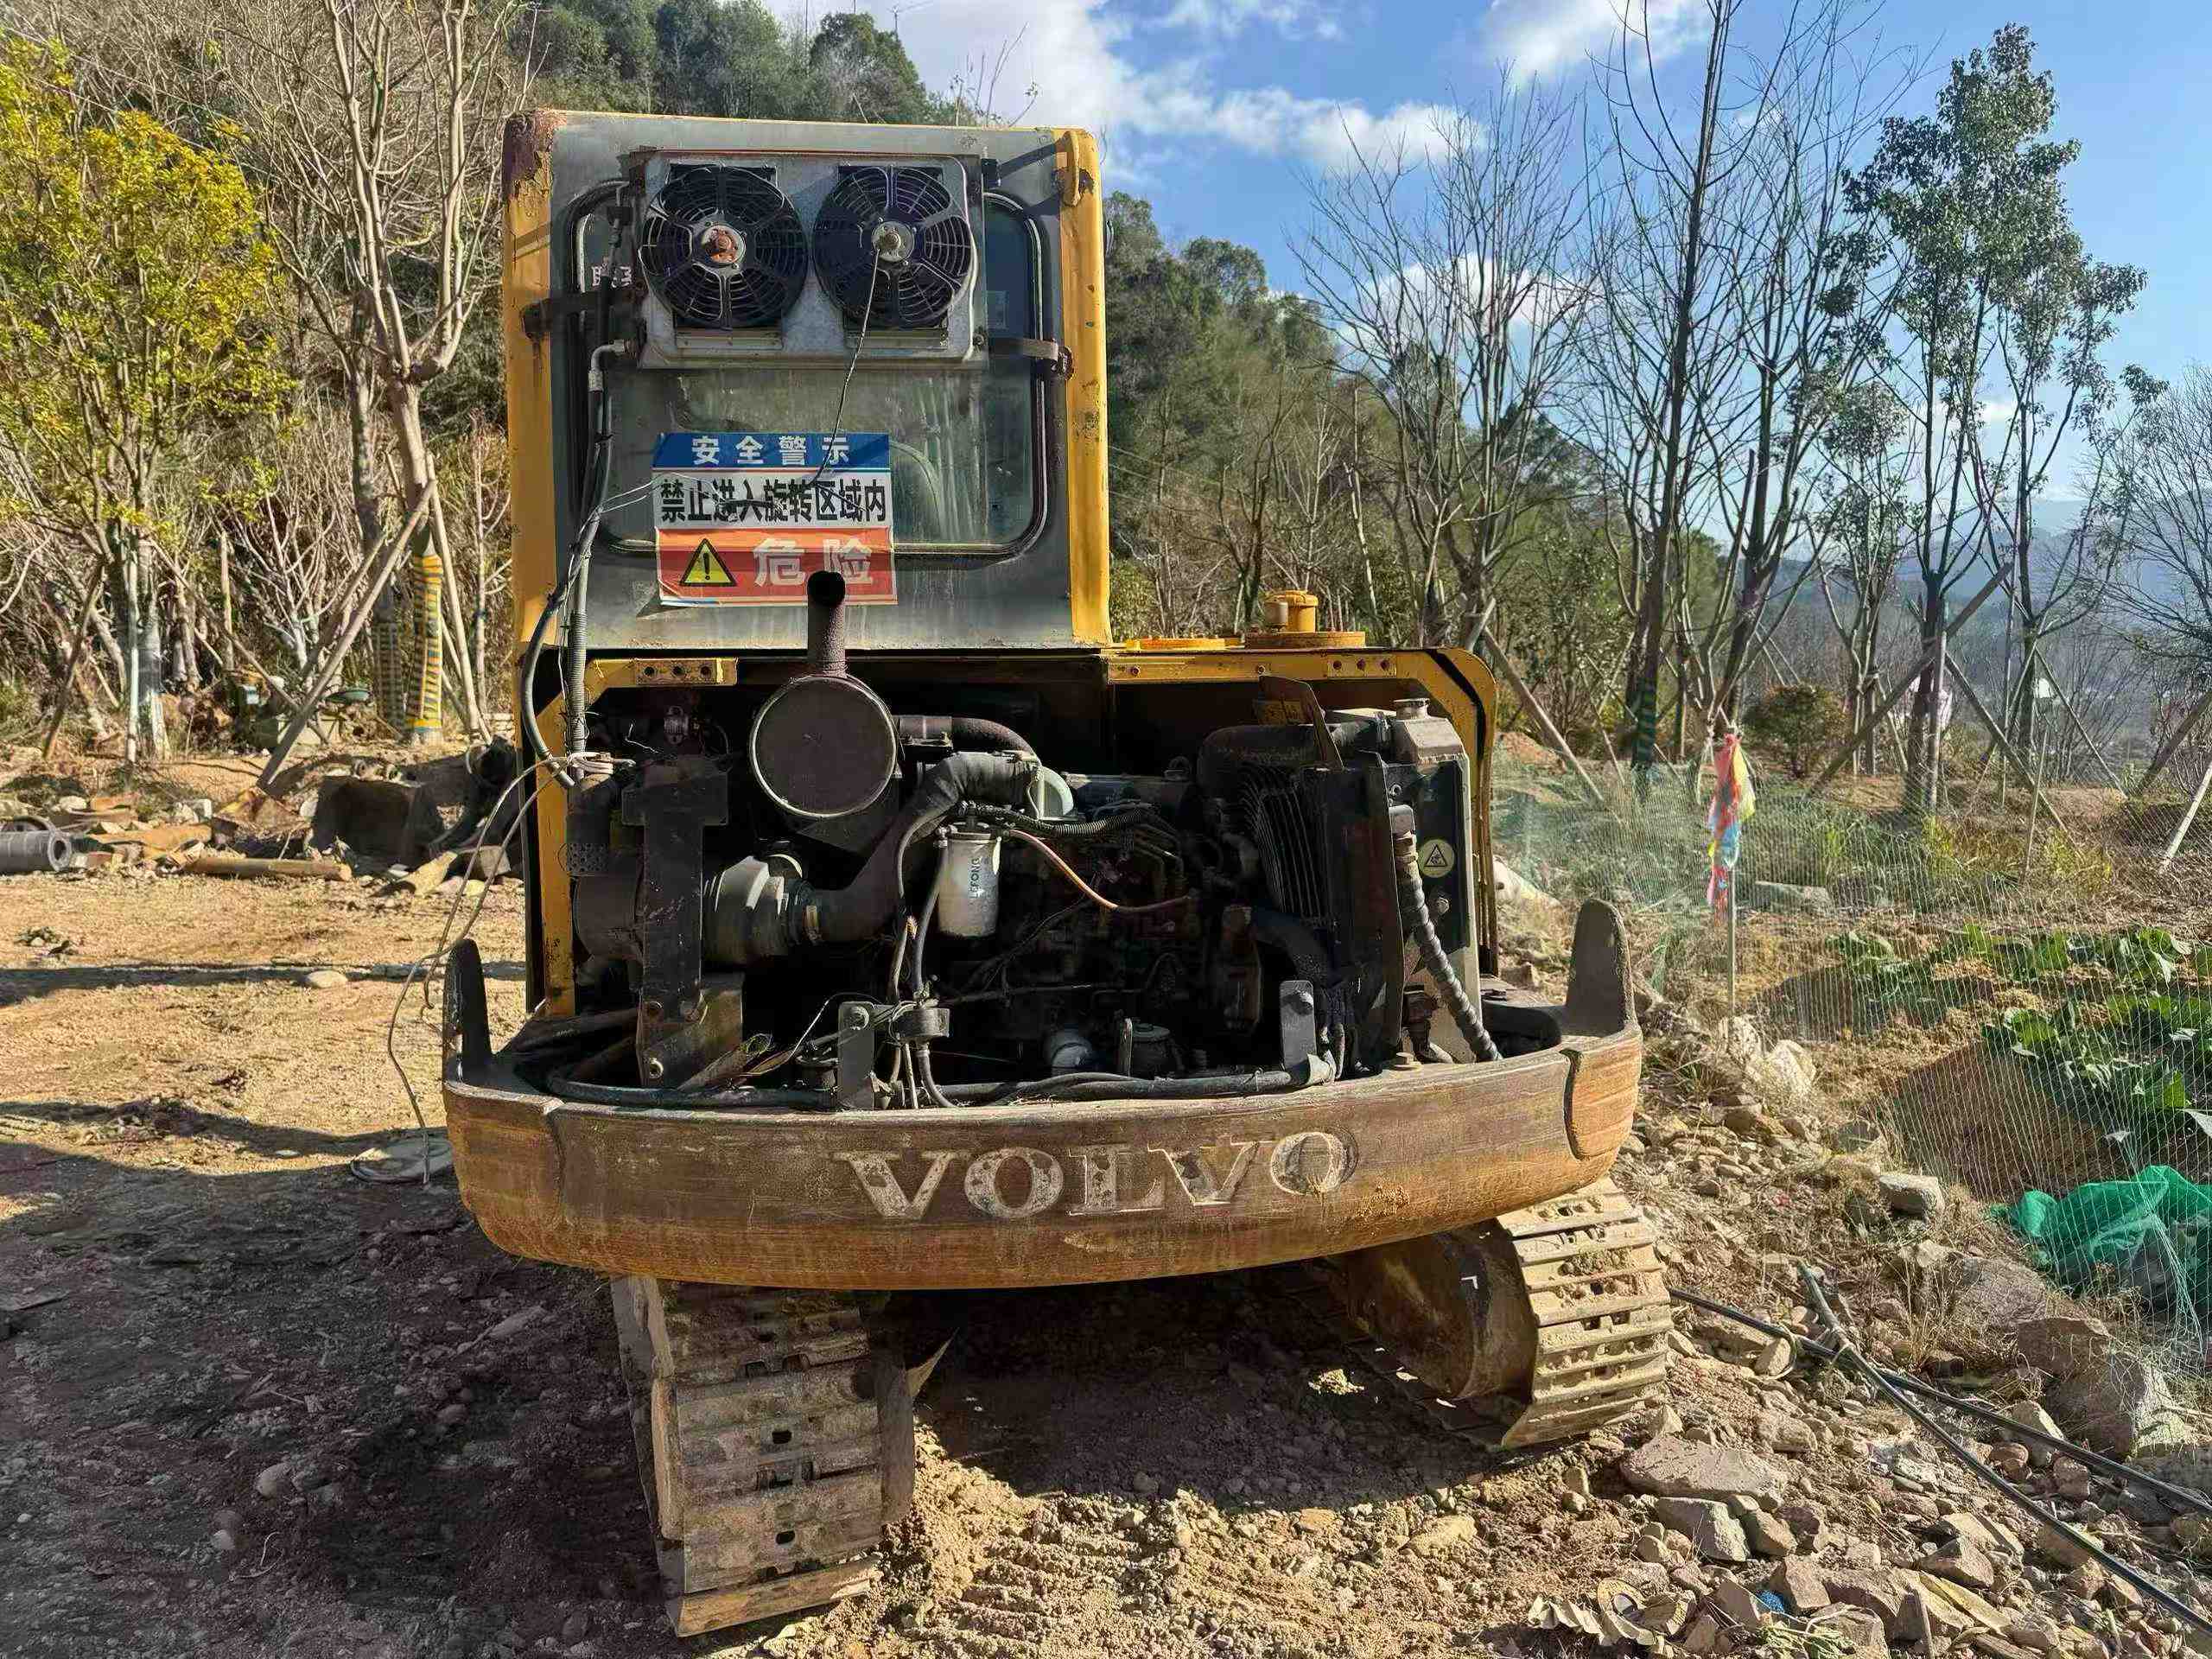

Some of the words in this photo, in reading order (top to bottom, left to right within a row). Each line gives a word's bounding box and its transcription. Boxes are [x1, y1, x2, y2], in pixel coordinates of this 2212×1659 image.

[691, 435, 850, 466] 安全警示
[660, 478, 887, 523] 禁止进入旋转区域内
[753, 537, 873, 587] 危险
[833, 1127, 1359, 1221] VOLVO
